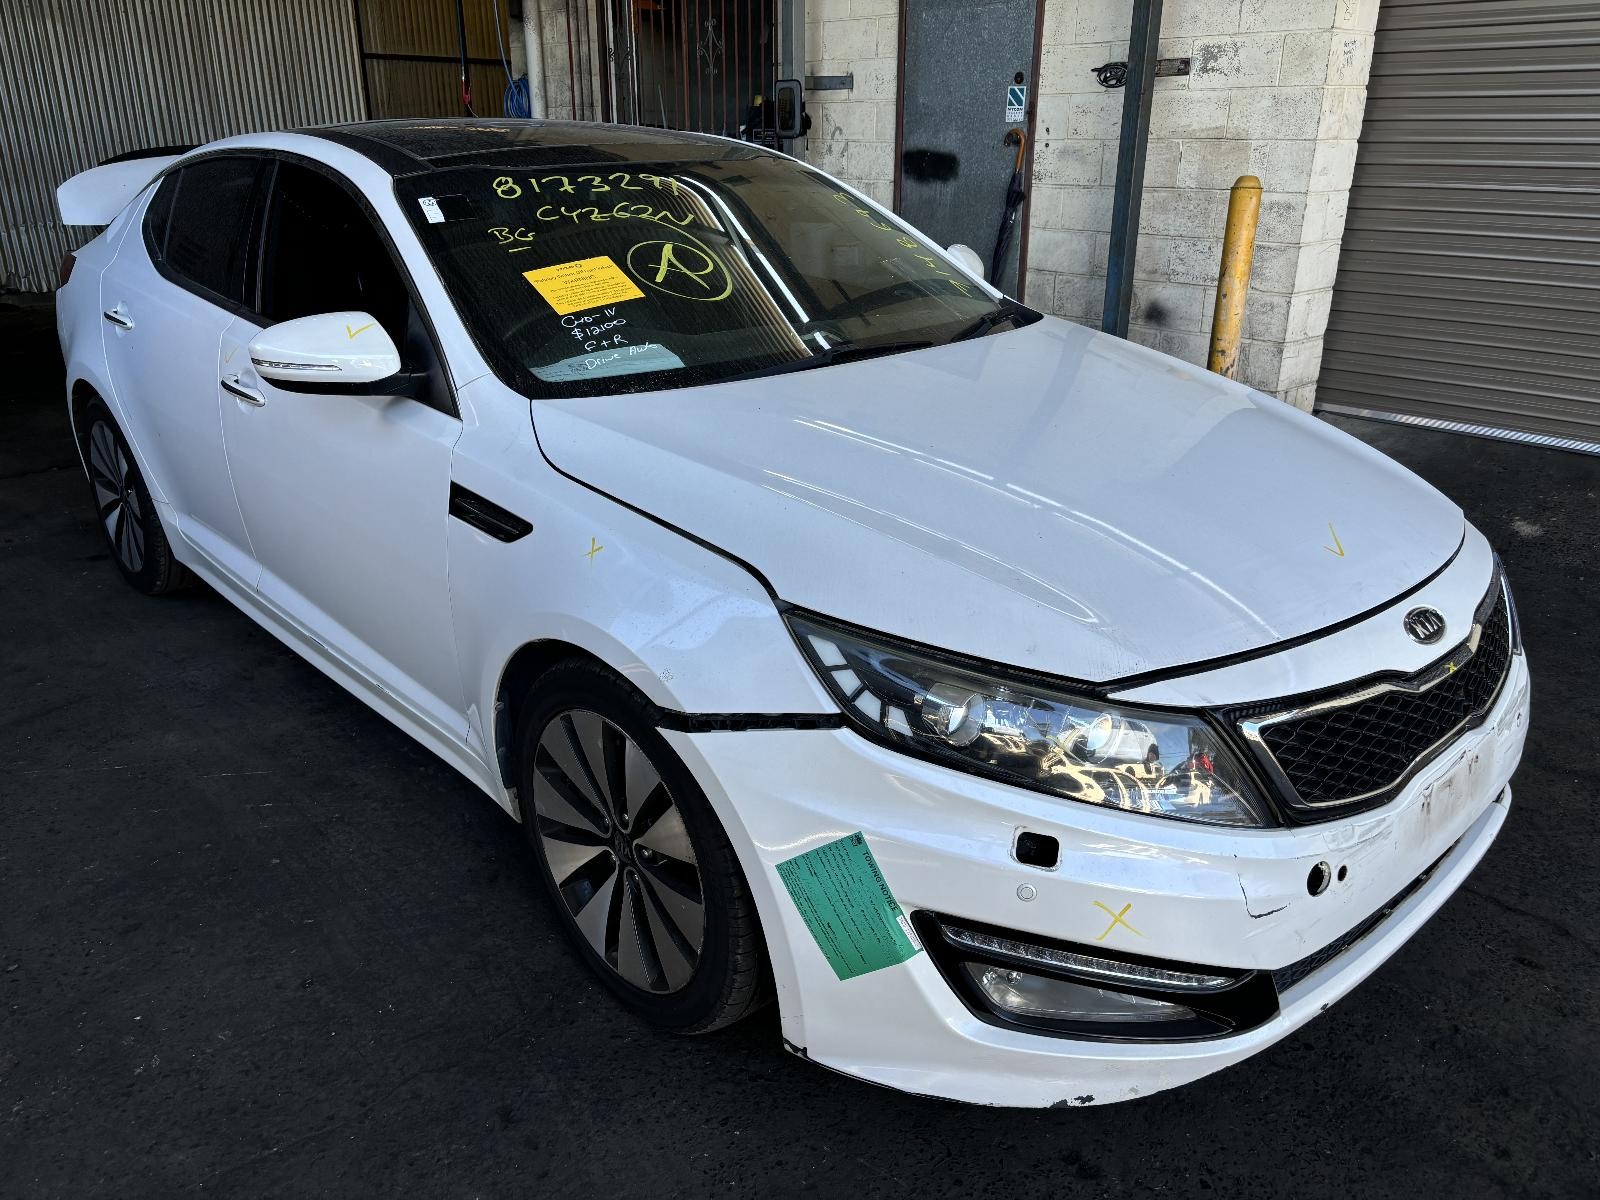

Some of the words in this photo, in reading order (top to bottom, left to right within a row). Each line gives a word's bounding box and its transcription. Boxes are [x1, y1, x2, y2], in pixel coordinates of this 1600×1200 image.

[647, 242, 712, 290] A
[1408, 611, 1442, 639] KIA
[862, 849, 882, 883] TOWING
[879, 883, 899, 912] NOTICE
